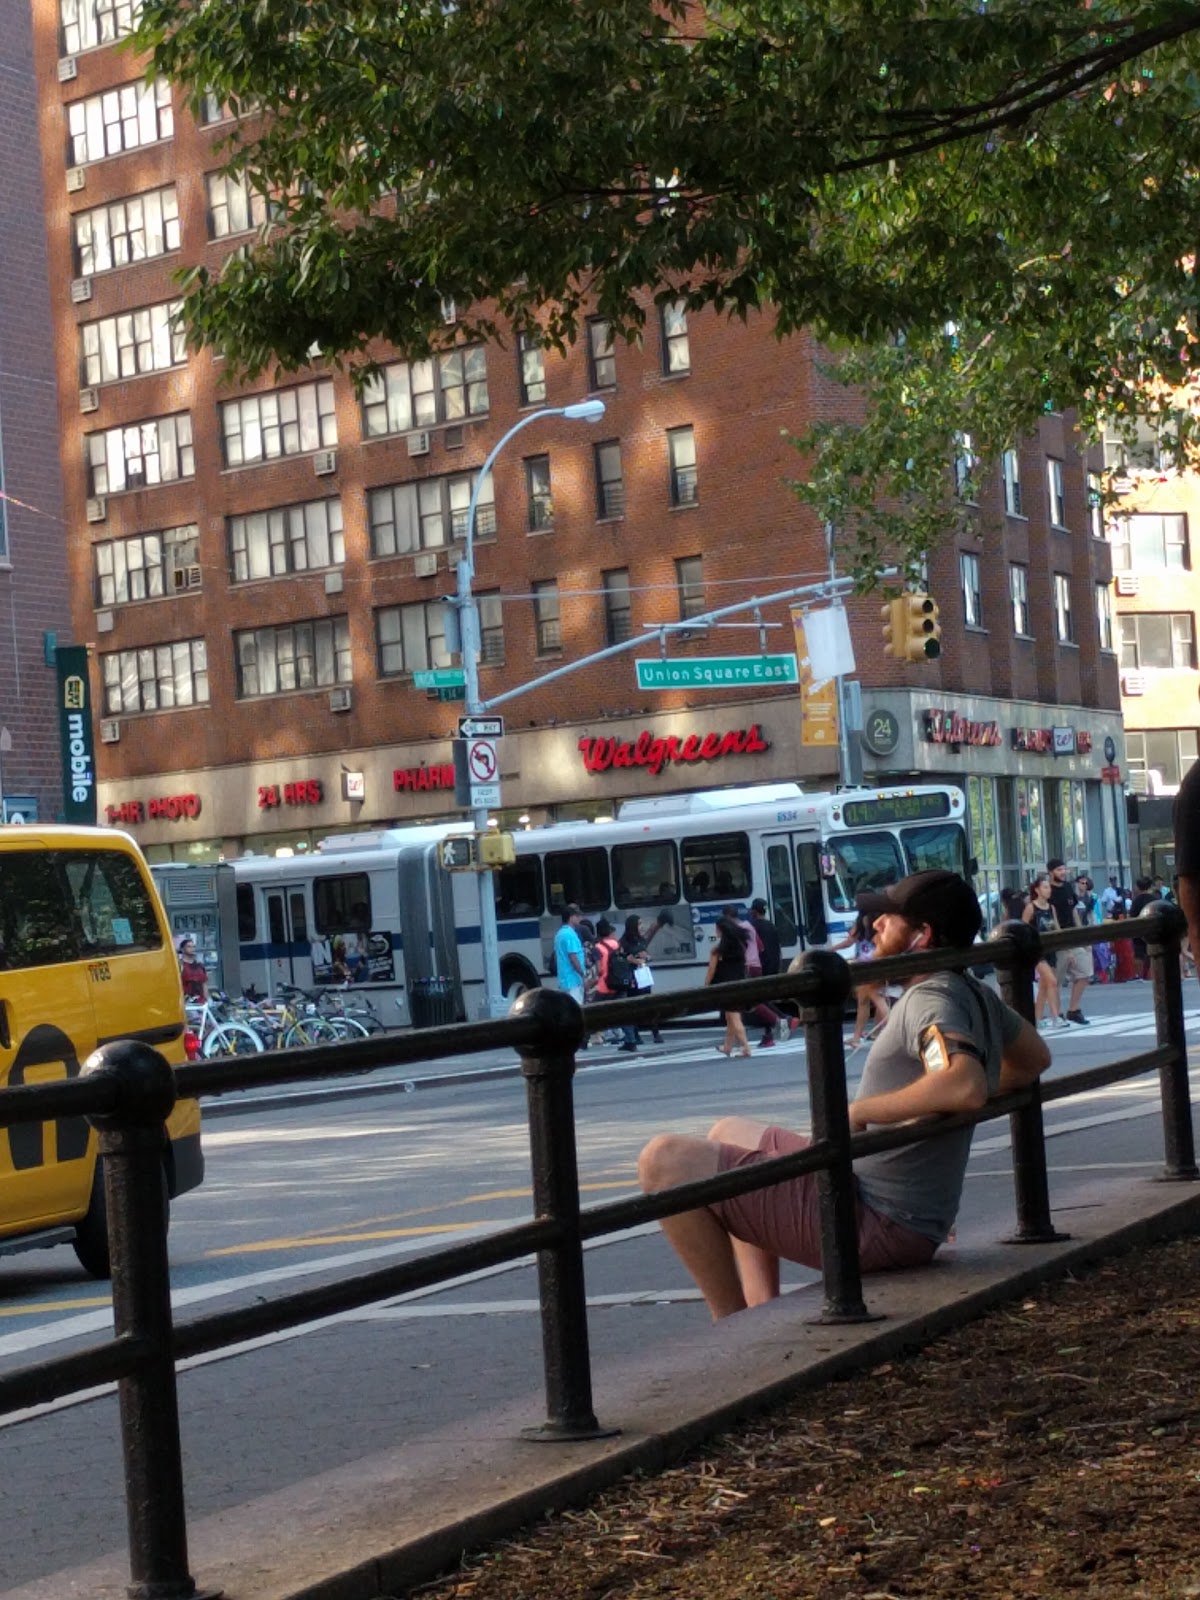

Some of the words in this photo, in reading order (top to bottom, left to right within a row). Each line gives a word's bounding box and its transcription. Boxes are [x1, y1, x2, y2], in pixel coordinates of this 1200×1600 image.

[643, 668, 690, 681] Union
[694, 665, 750, 682] Square
[753, 663, 790, 678] East
[873, 718, 892, 738] 24
[68, 713, 92, 802] mobile
[578, 723, 768, 775] Walgreens
[104, 802, 143, 824] 1-HR
[149, 793, 199, 820] PHOTO
[257, 784, 279, 809] 24
[283, 779, 321, 805] HRS
